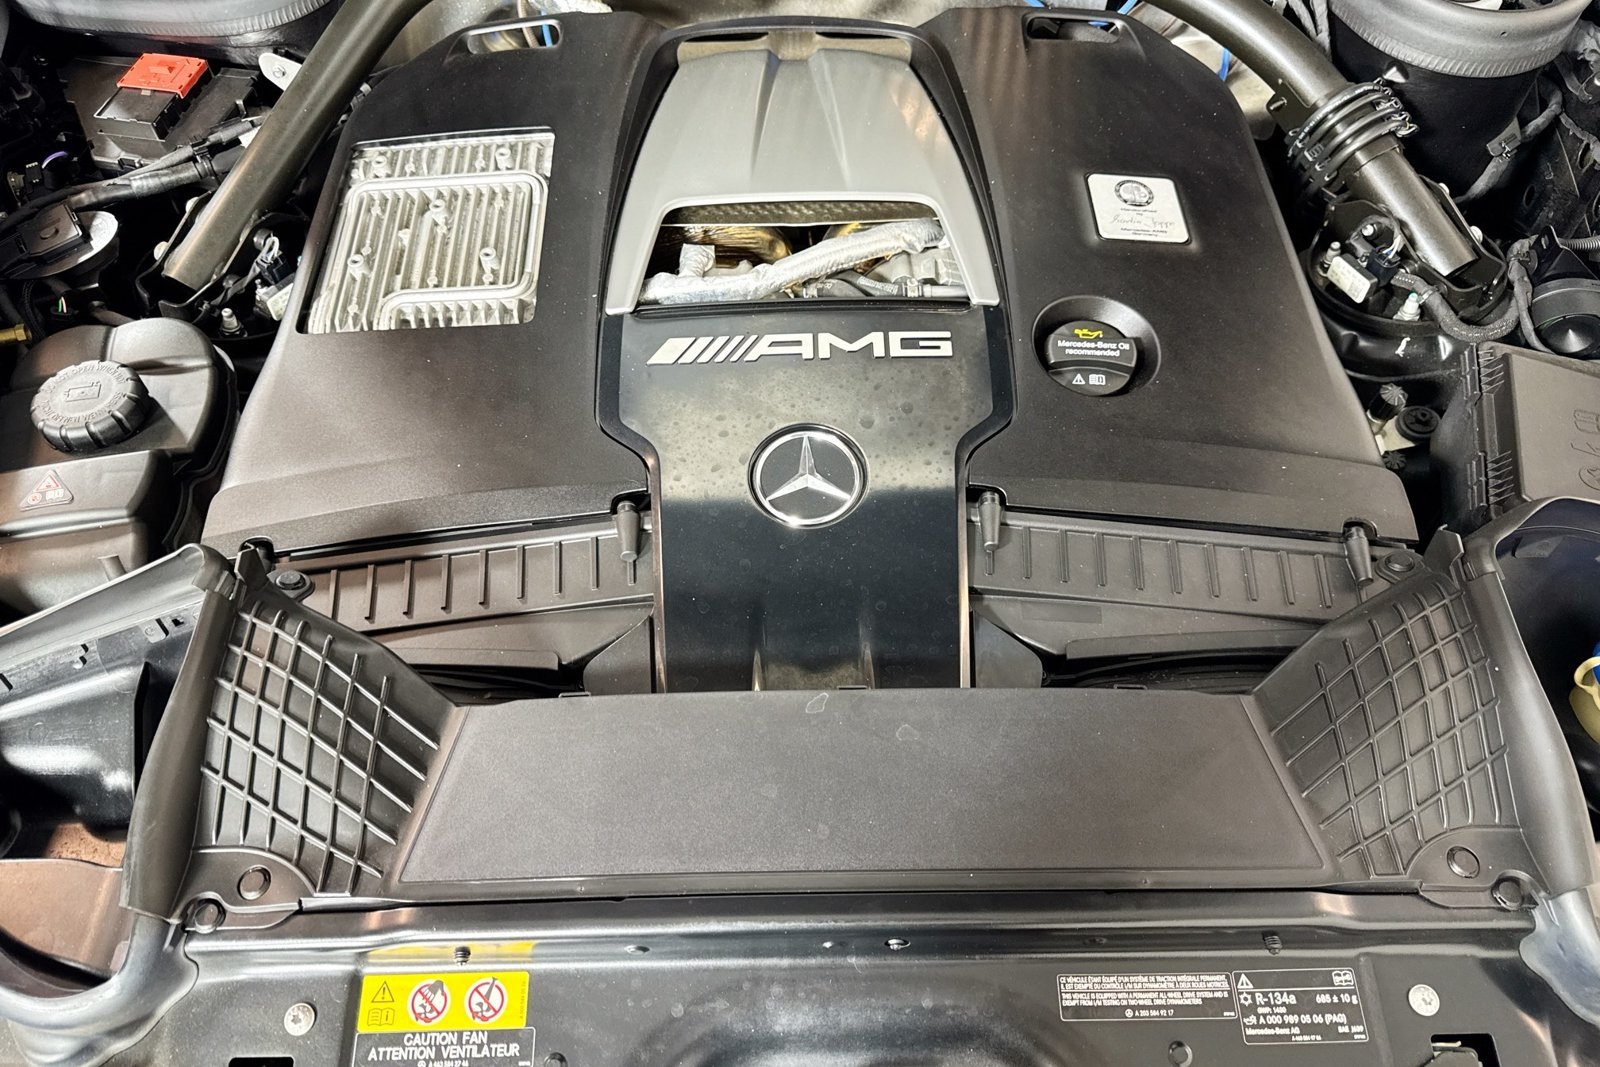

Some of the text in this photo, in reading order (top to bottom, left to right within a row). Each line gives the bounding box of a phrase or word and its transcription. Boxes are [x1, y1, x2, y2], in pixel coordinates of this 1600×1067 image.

[744, 331, 953, 362] AMG
[1057, 340, 1130, 350] Mercedes-Benz Oil
[1065, 348, 1120, 356] recommended
[1254, 992, 1297, 1005] R-134a
[1316, 993, 1332, 1004] 685
[1340, 993, 1350, 1003] 10
[1351, 994, 1358, 1005] g
[1259, 1013, 1347, 1025] A 000 989 05 06 (PAG)
[1245, 1026, 1301, 1035] Mercedes-Benz AG
[403, 1030, 488, 1046] CAUTION FAN
[367, 1043, 520, 1061] ATTENTION VENTILATEUR
